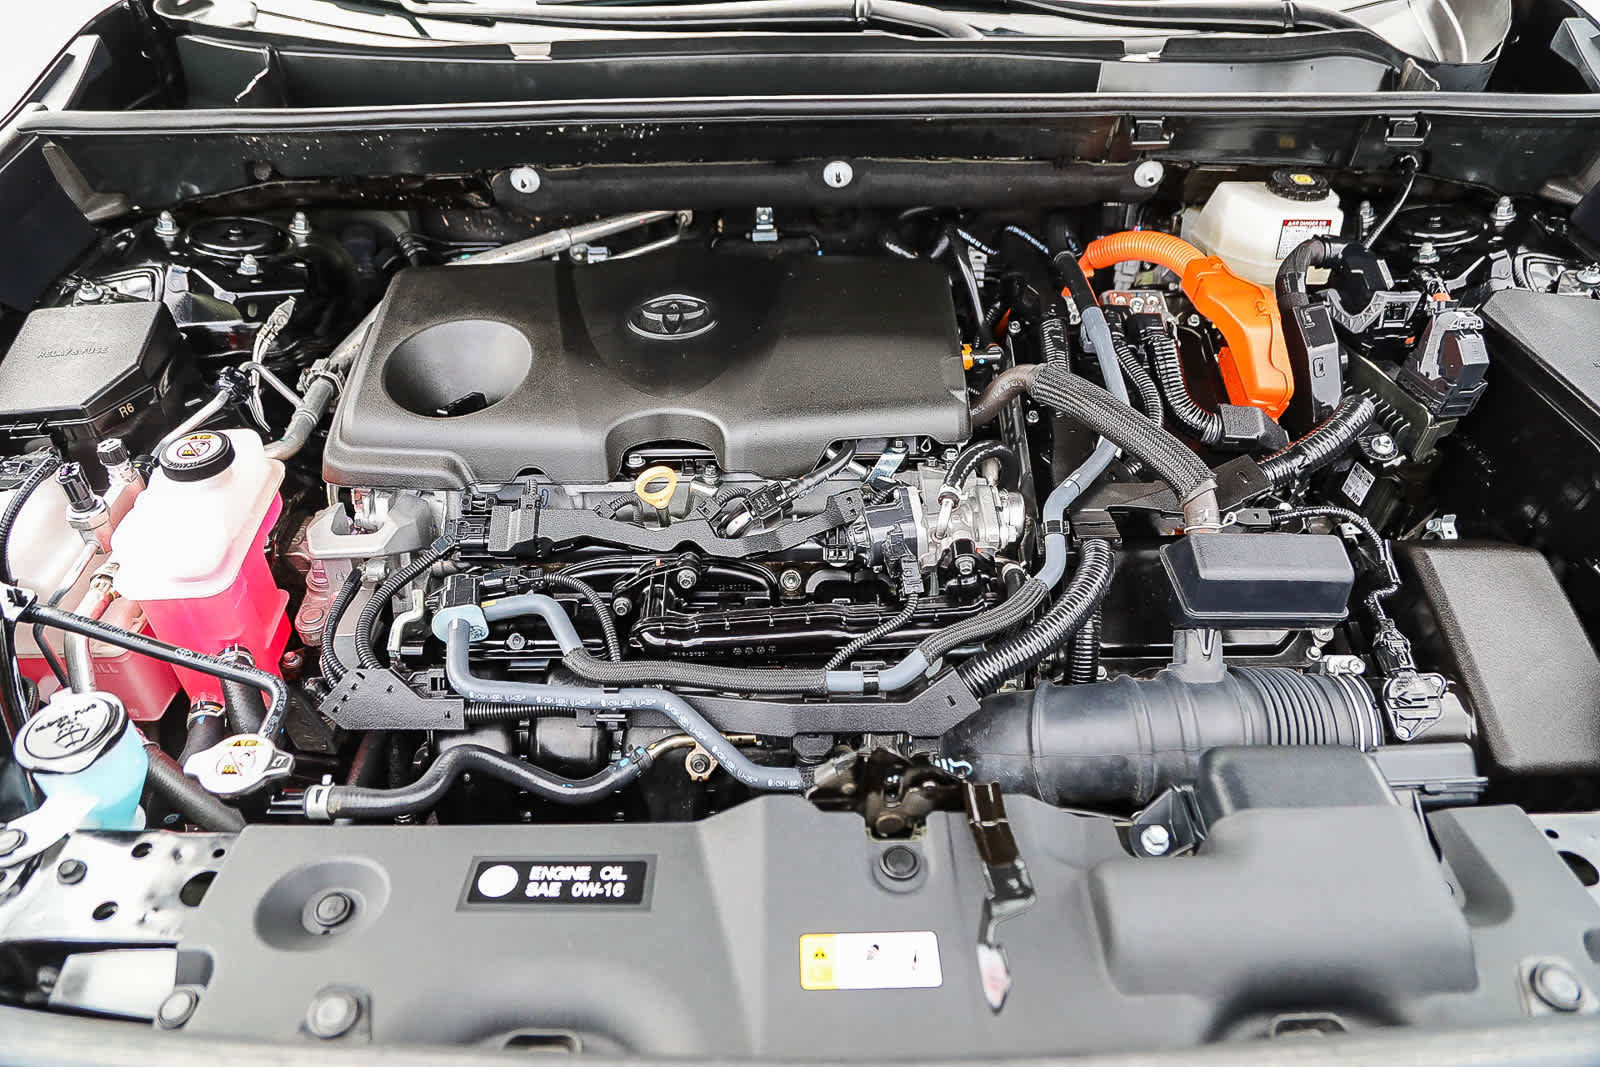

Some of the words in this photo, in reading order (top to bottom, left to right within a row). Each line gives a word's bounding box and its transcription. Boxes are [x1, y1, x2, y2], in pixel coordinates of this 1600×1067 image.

[119, 402, 135, 418] R6
[529, 865, 591, 881] ENGINE
[599, 865, 628, 881] OIL
[525, 882, 562, 897] SAE
